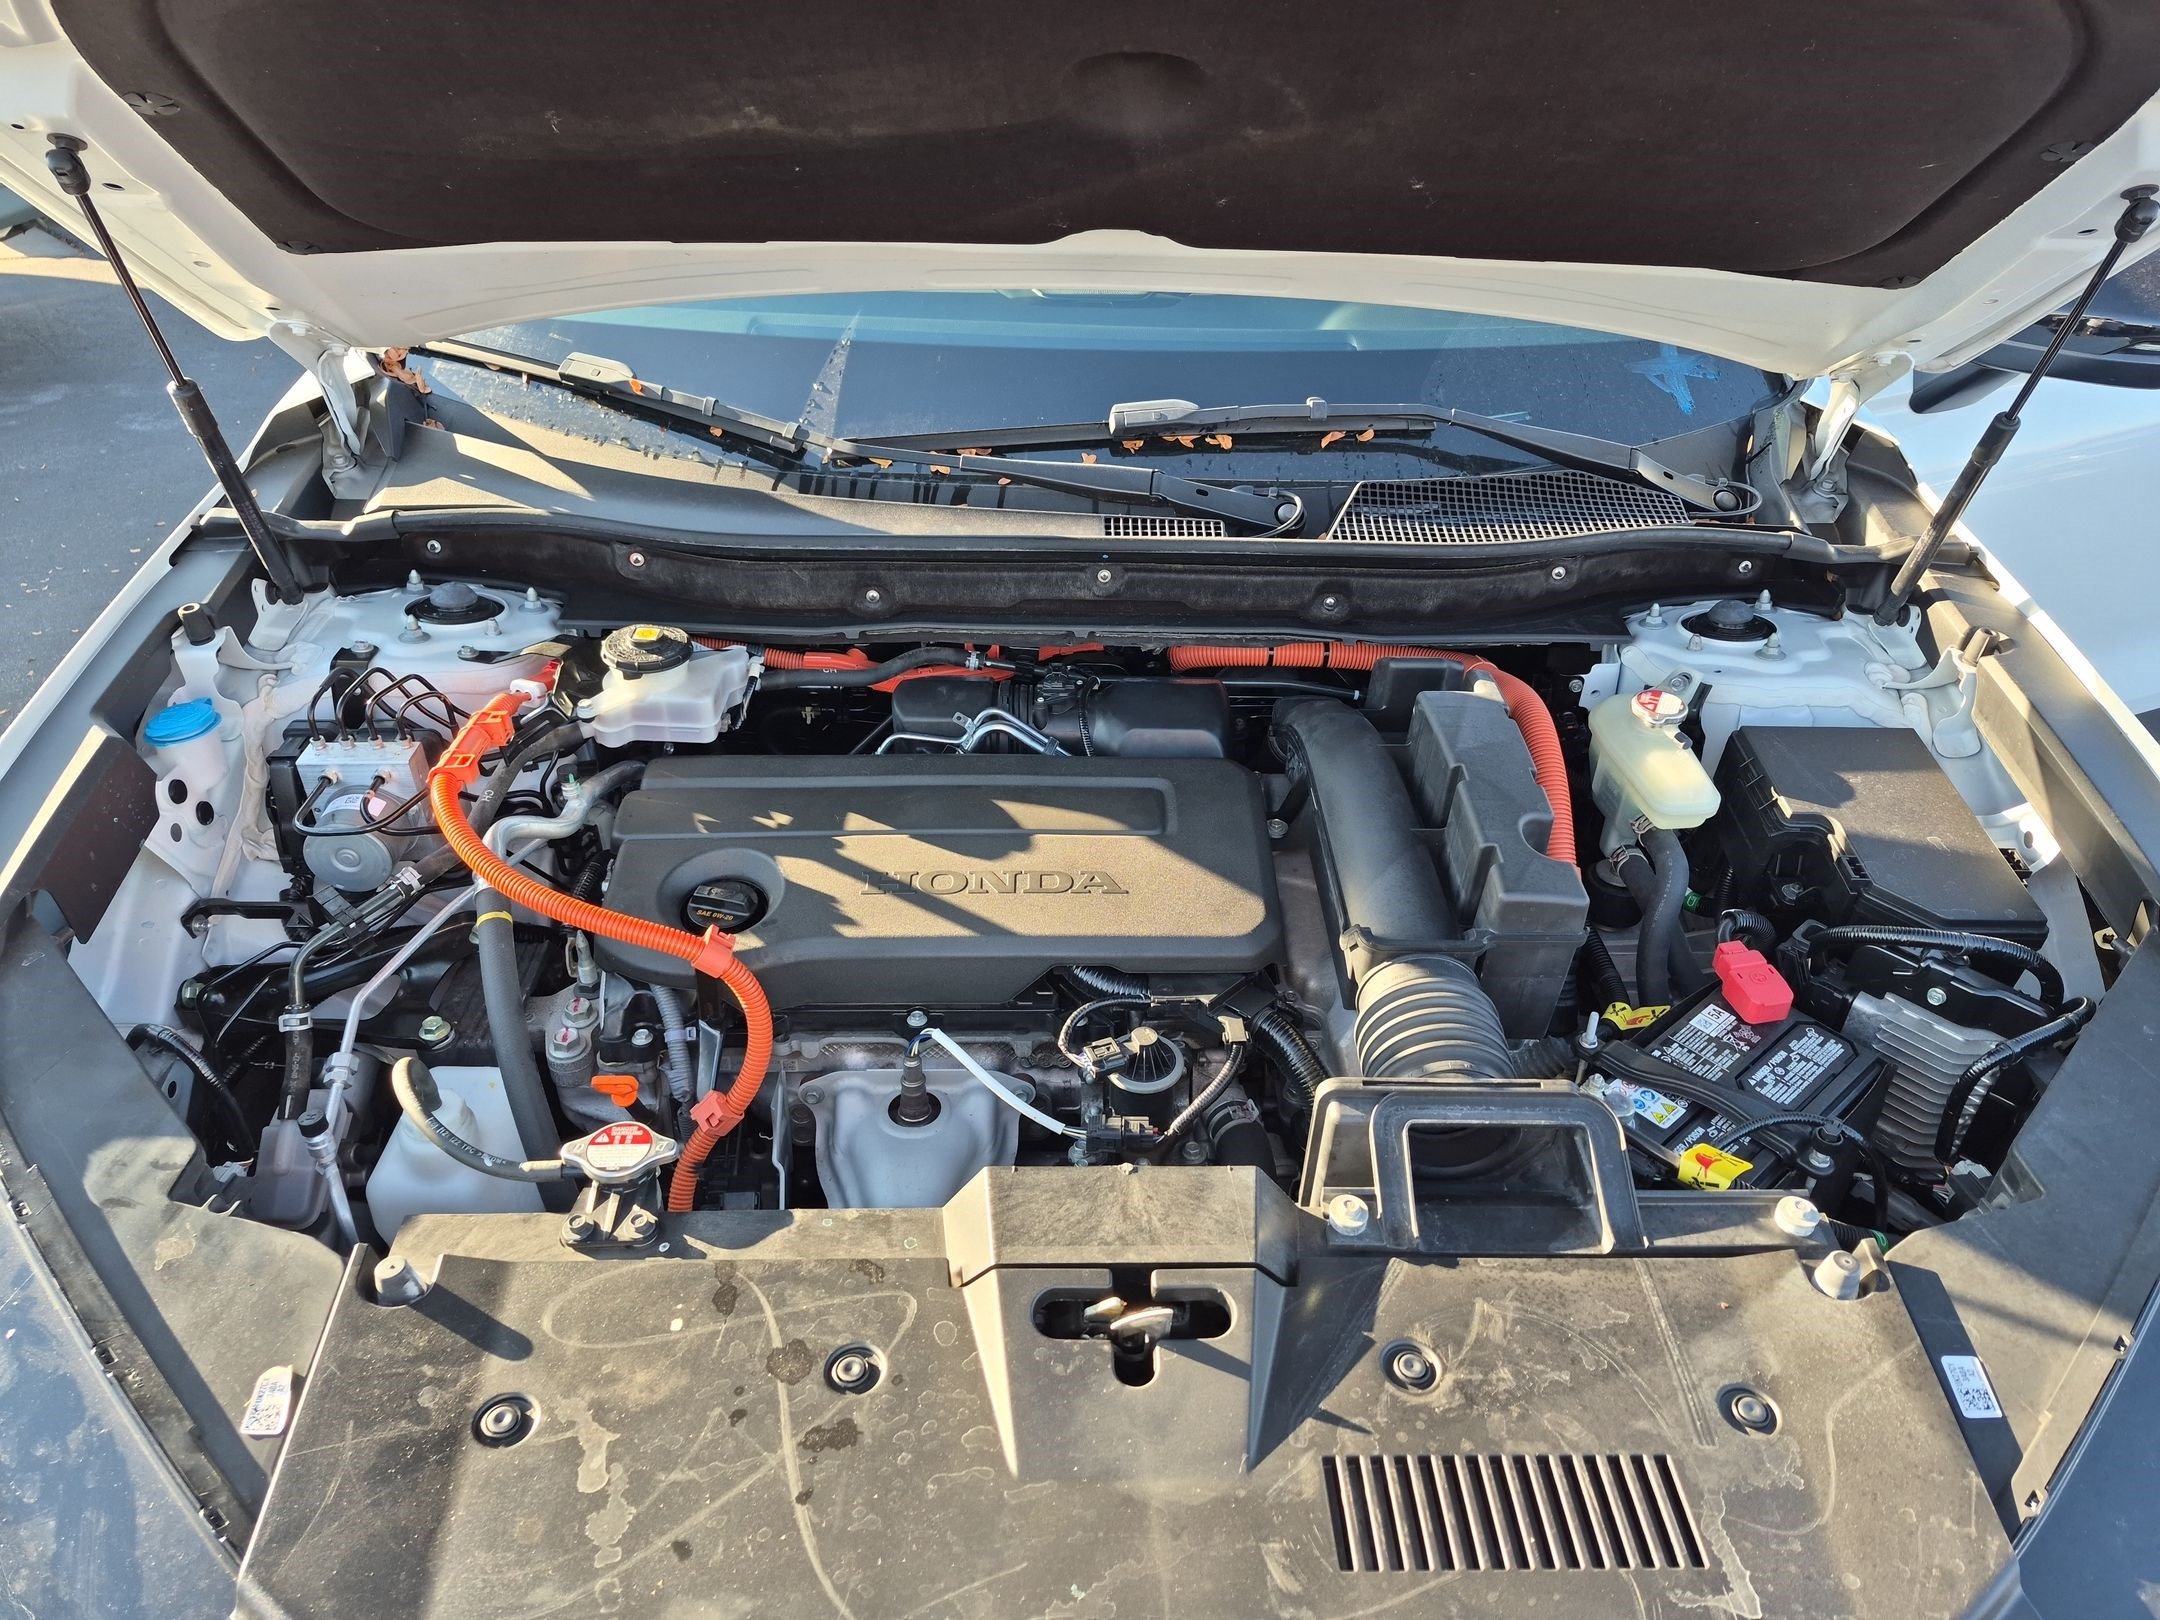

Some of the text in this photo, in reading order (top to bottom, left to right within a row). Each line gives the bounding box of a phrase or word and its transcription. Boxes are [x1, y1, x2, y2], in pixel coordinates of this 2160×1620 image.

[860, 870, 1130, 895] HONDA
[697, 909, 734, 920] SAE 0W-20
[1707, 1008, 1725, 1020] 5A
